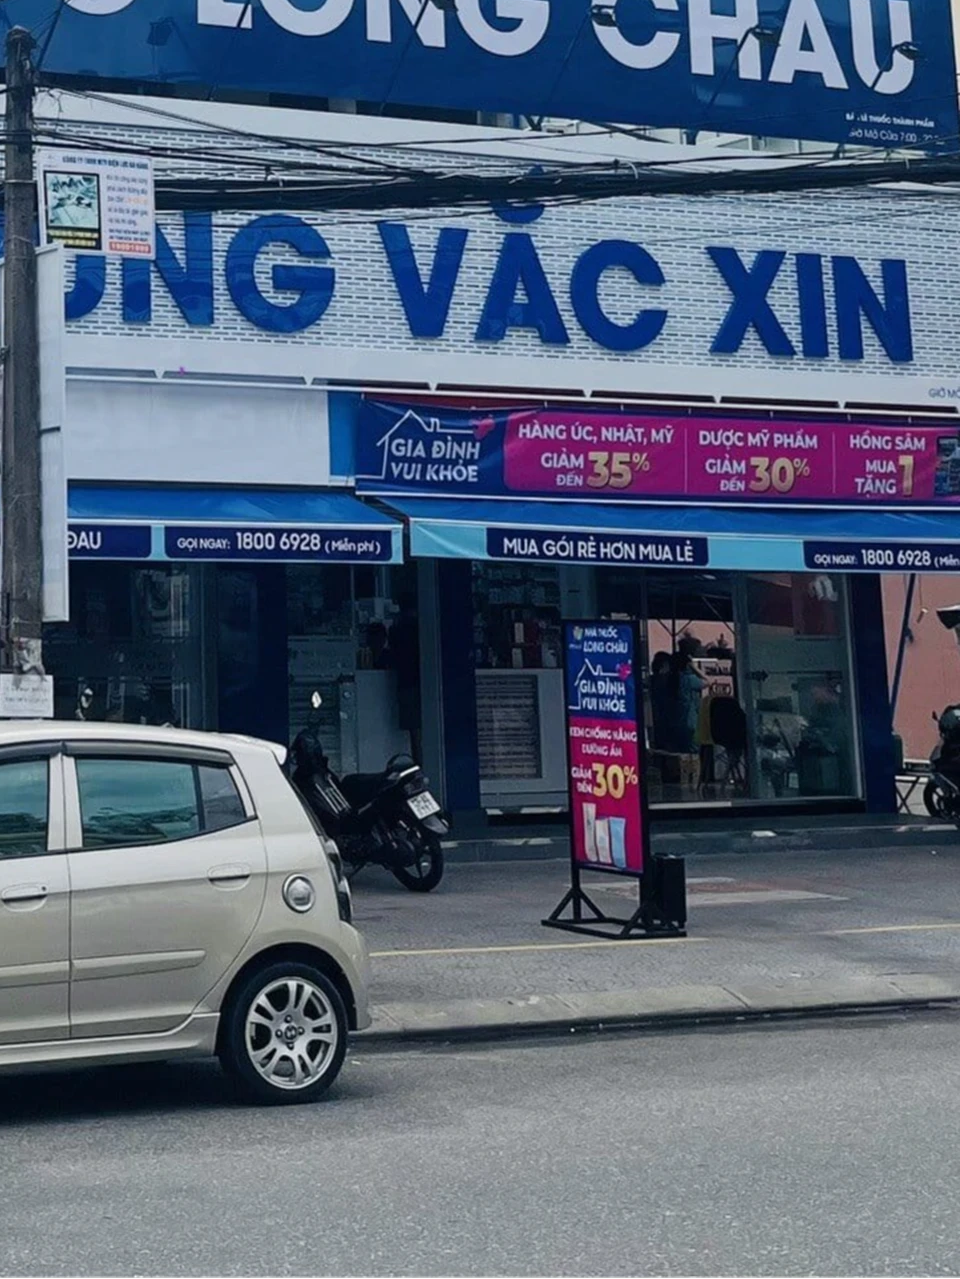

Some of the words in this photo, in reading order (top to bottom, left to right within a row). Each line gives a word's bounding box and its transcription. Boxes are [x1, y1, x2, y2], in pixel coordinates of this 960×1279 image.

[705, 246, 914, 362] XIN
[519, 420, 567, 440] HÀNG
[571, 421, 597, 443] ÚC,
[601, 423, 647, 446] NHẬT,
[651, 425, 674, 443] MỸ
[699, 429, 745, 451] DƯỢC
[748, 428, 770, 448] MỸ
[774, 429, 818, 449] PHẨM
[850, 431, 892, 451] HỒNG
[895, 432, 926, 452] SÂM
[391, 439, 426, 458] GIA
[431, 435, 481, 460] ĐÌNH
[390, 462, 422, 480] VUI
[427, 459, 478, 482] KHỎE
[541, 448, 584, 470] GIẢM
[587, 451, 651, 489] 35%
[556, 471, 583, 487] ĐẾN
[705, 455, 746, 474] GIẢM
[749, 456, 810, 494] 30%
[866, 459, 897, 474] MUA
[898, 455, 914, 496] 1
[720, 475, 745, 492] ĐẾN
[855, 475, 897, 498] TẶNG
[177, 538, 198, 551] GỌI
[200, 538, 230, 549] NGAY:
[236, 532, 275, 549] 1800
[279, 533, 321, 551] 6928
[503, 538, 539, 555] MUA
[543, 535, 573, 557] GÓI
[578, 536, 596, 558] RẺ
[600, 540, 636, 560] HƠN
[640, 544, 673, 561] MUA
[676, 540, 693, 561] LẺ
[814, 554, 831, 567] GỌI
[832, 554, 858, 565] NGAY:
[861, 549, 893, 565] 1800
[897, 550, 931, 566] 6928
[583, 641, 605, 653] LONG
[605, 639, 628, 653] CHÂU
[580, 679, 597, 694] GIA
[597, 677, 626, 696] ĐÌNH
[582, 698, 597, 710] VUI
[599, 695, 627, 713] KHỎE
[592, 762, 638, 799] 30%
